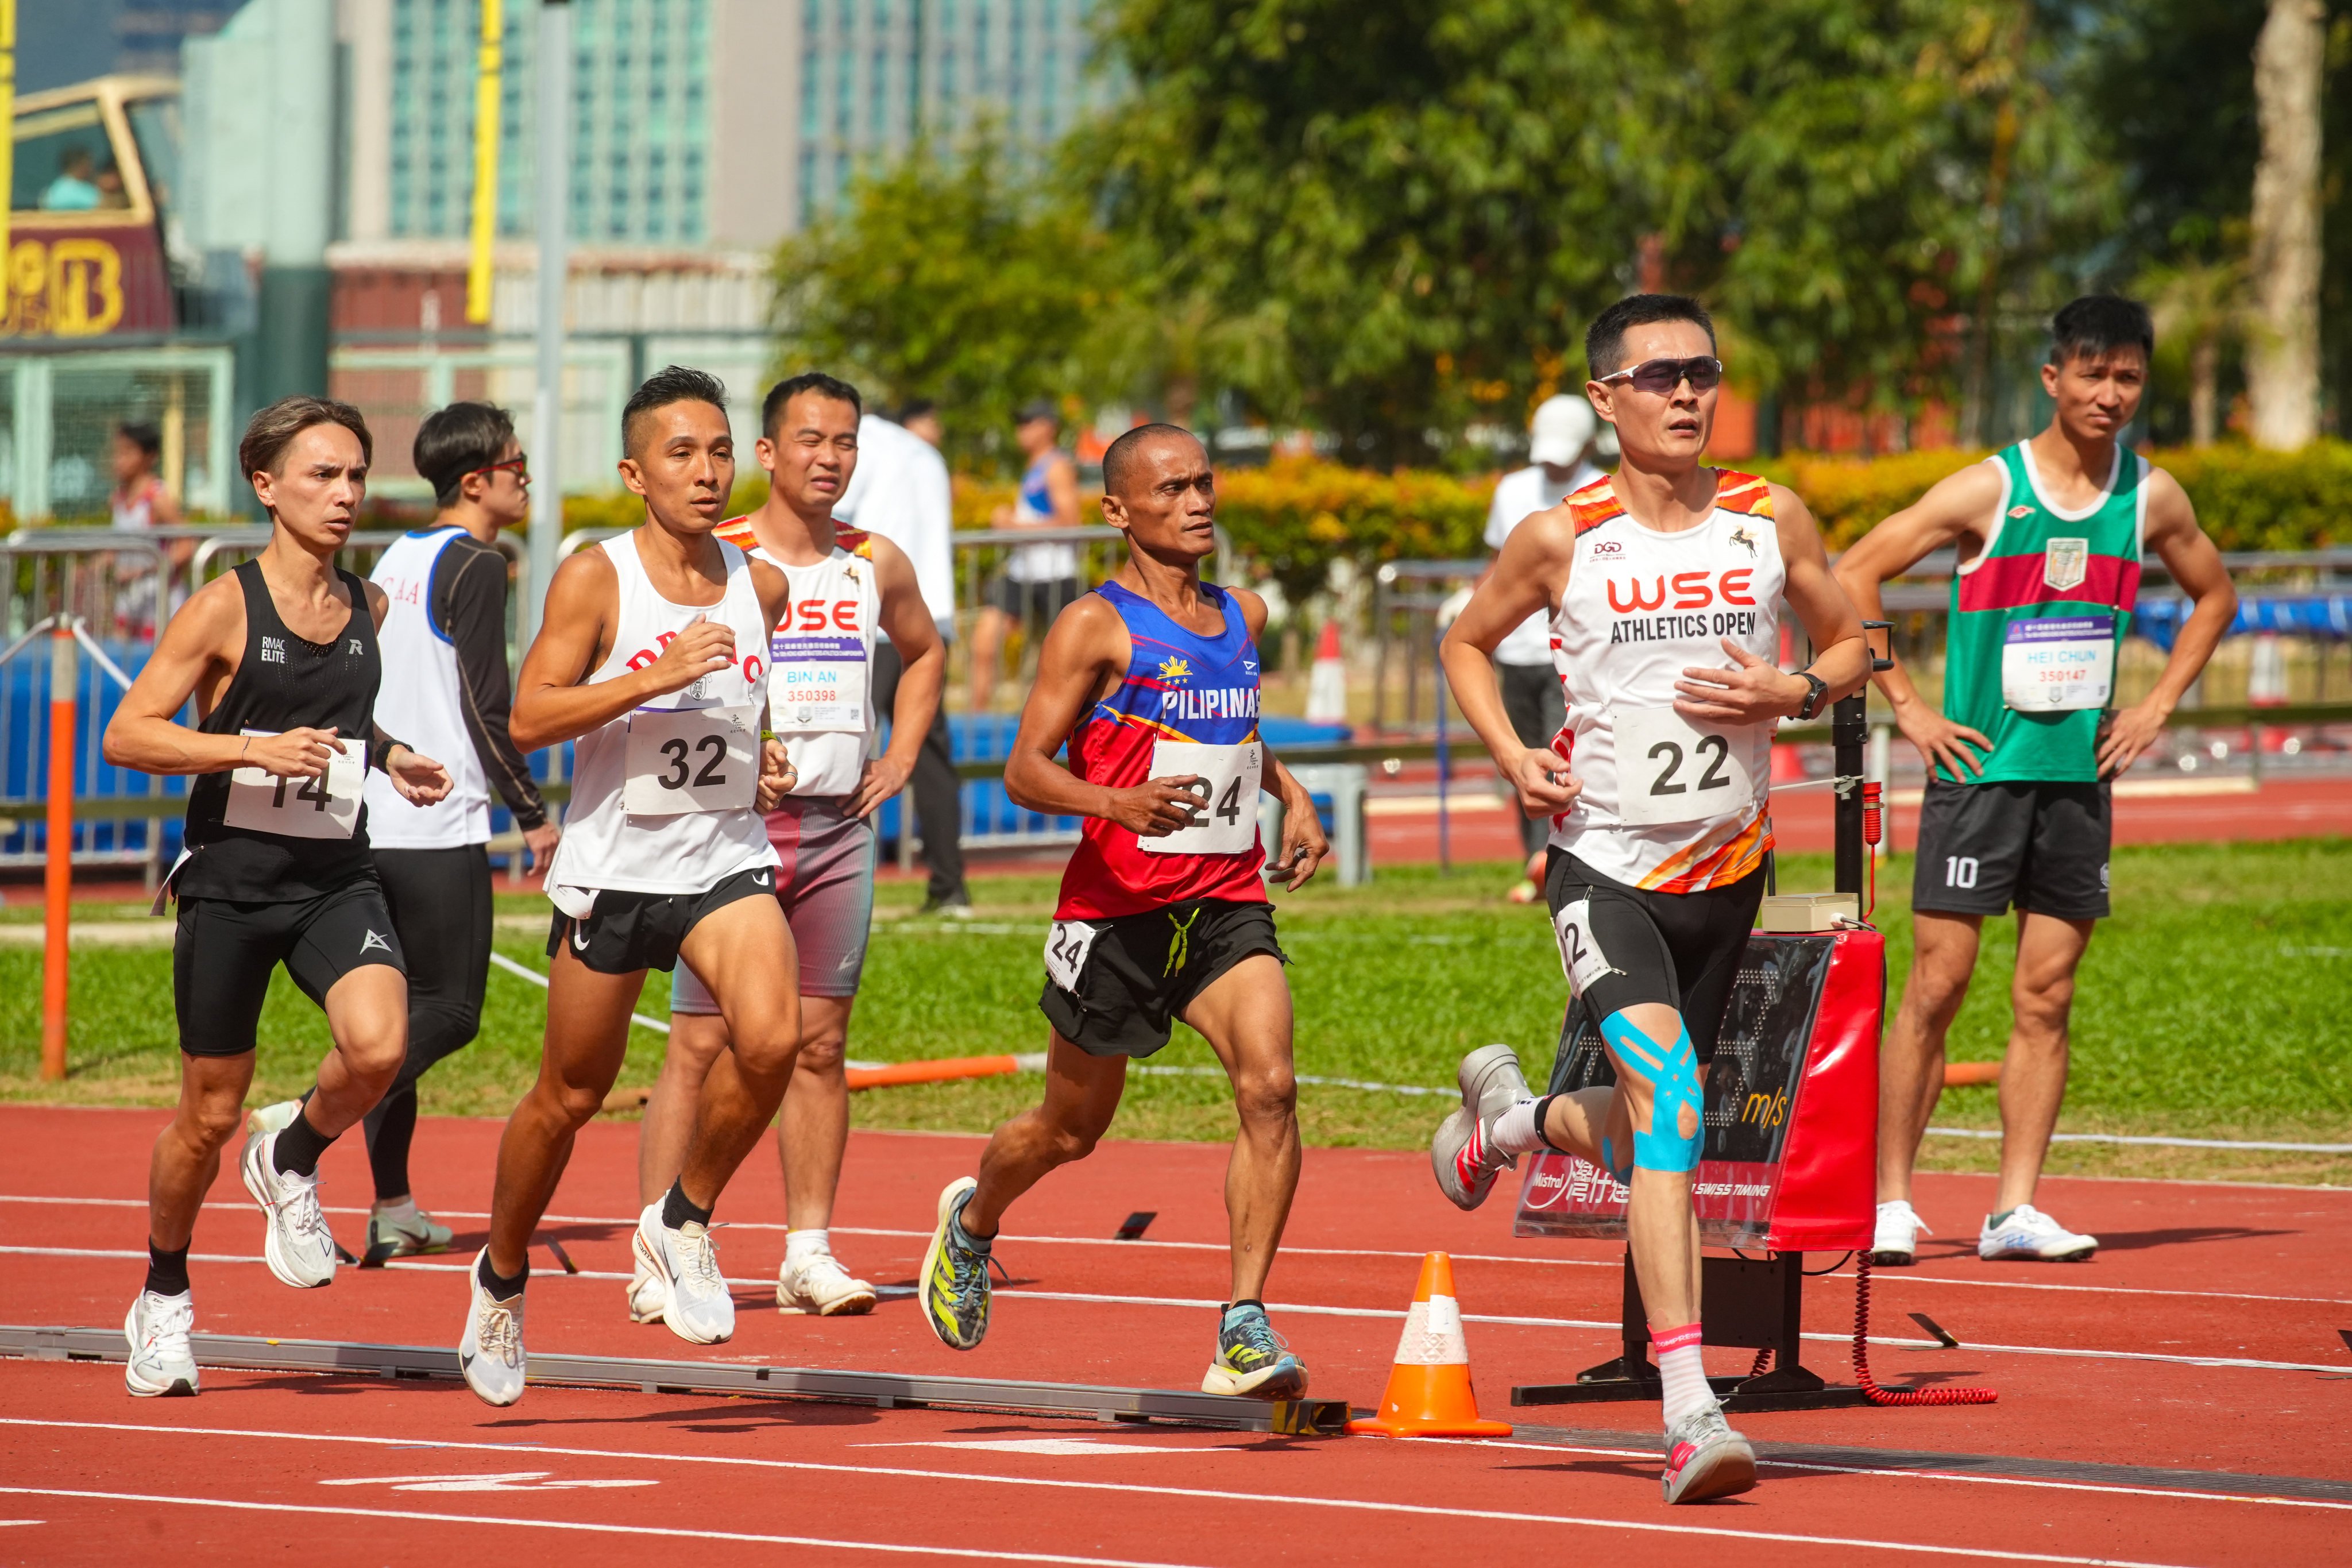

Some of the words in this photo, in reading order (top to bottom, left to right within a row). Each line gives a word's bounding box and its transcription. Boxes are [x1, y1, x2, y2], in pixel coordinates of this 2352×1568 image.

[1607, 568, 1756, 613] WSE
[1611, 614, 1708, 644] ATHLETICS
[1713, 612, 1756, 636] OPEN
[262, 636, 285, 651] RMAC
[261, 649, 285, 664] ELITE
[2027, 651, 2054, 663] HEI
[2058, 650, 2096, 662] CHUN
[787, 671, 813, 683] BIN
[817, 671, 837, 683] AN
[2039, 669, 2087, 682] 350147
[787, 690, 836, 702] 350398
[1160, 688, 1260, 720] PILIPINAS
[658, 735, 727, 790] 32
[1647, 735, 1730, 796] 22
[1946, 856, 1979, 889] 10
[1052, 923, 1083, 974] 24
[1741, 1086, 1788, 1129] m/s
[1532, 1172, 1565, 1188] Mistral
[1694, 1183, 1733, 1196] SWISS
[1732, 1184, 1771, 1197] TIMING
